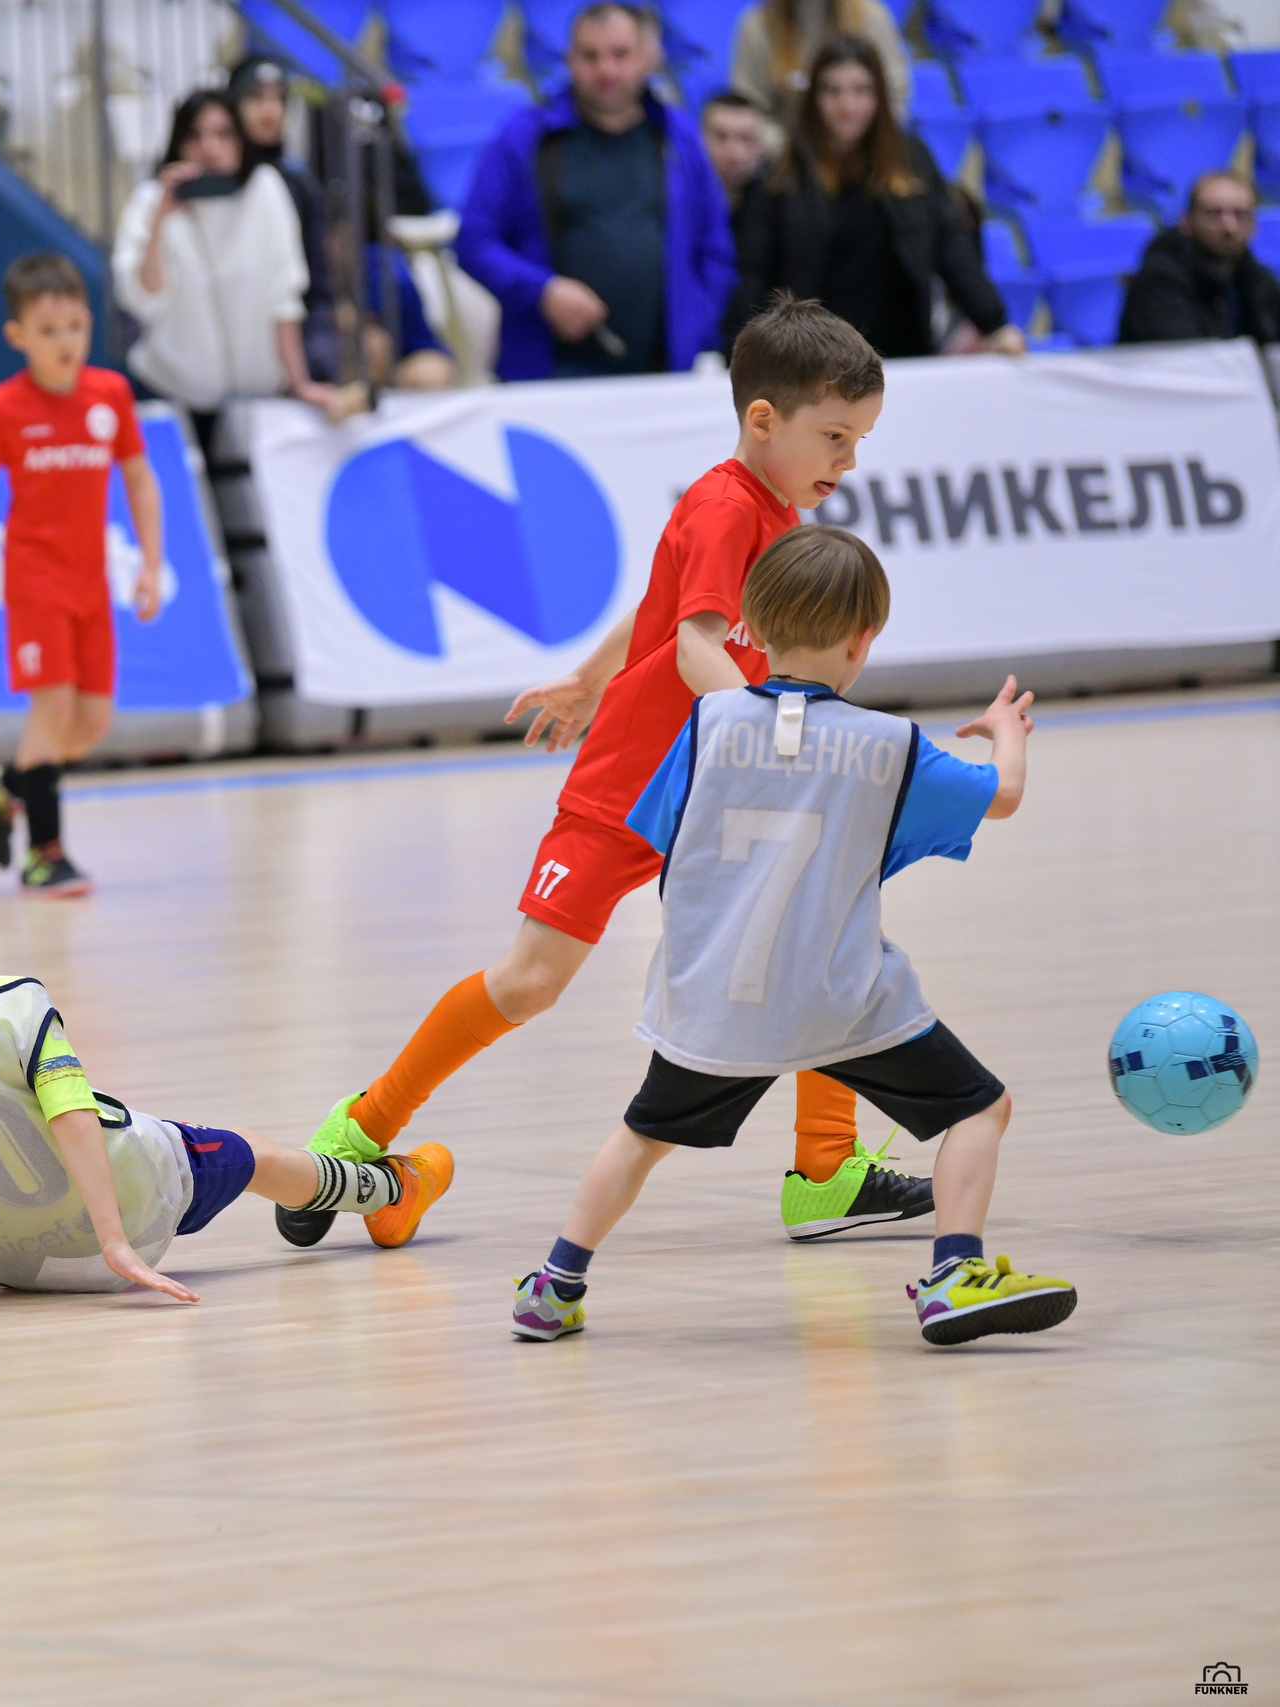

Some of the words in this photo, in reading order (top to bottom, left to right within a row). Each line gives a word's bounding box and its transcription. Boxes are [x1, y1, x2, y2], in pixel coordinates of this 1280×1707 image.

[673, 453, 1245, 546] РНИКЕЛЬ
[534, 859, 571, 900] 17
[720, 808, 823, 1005] 7
